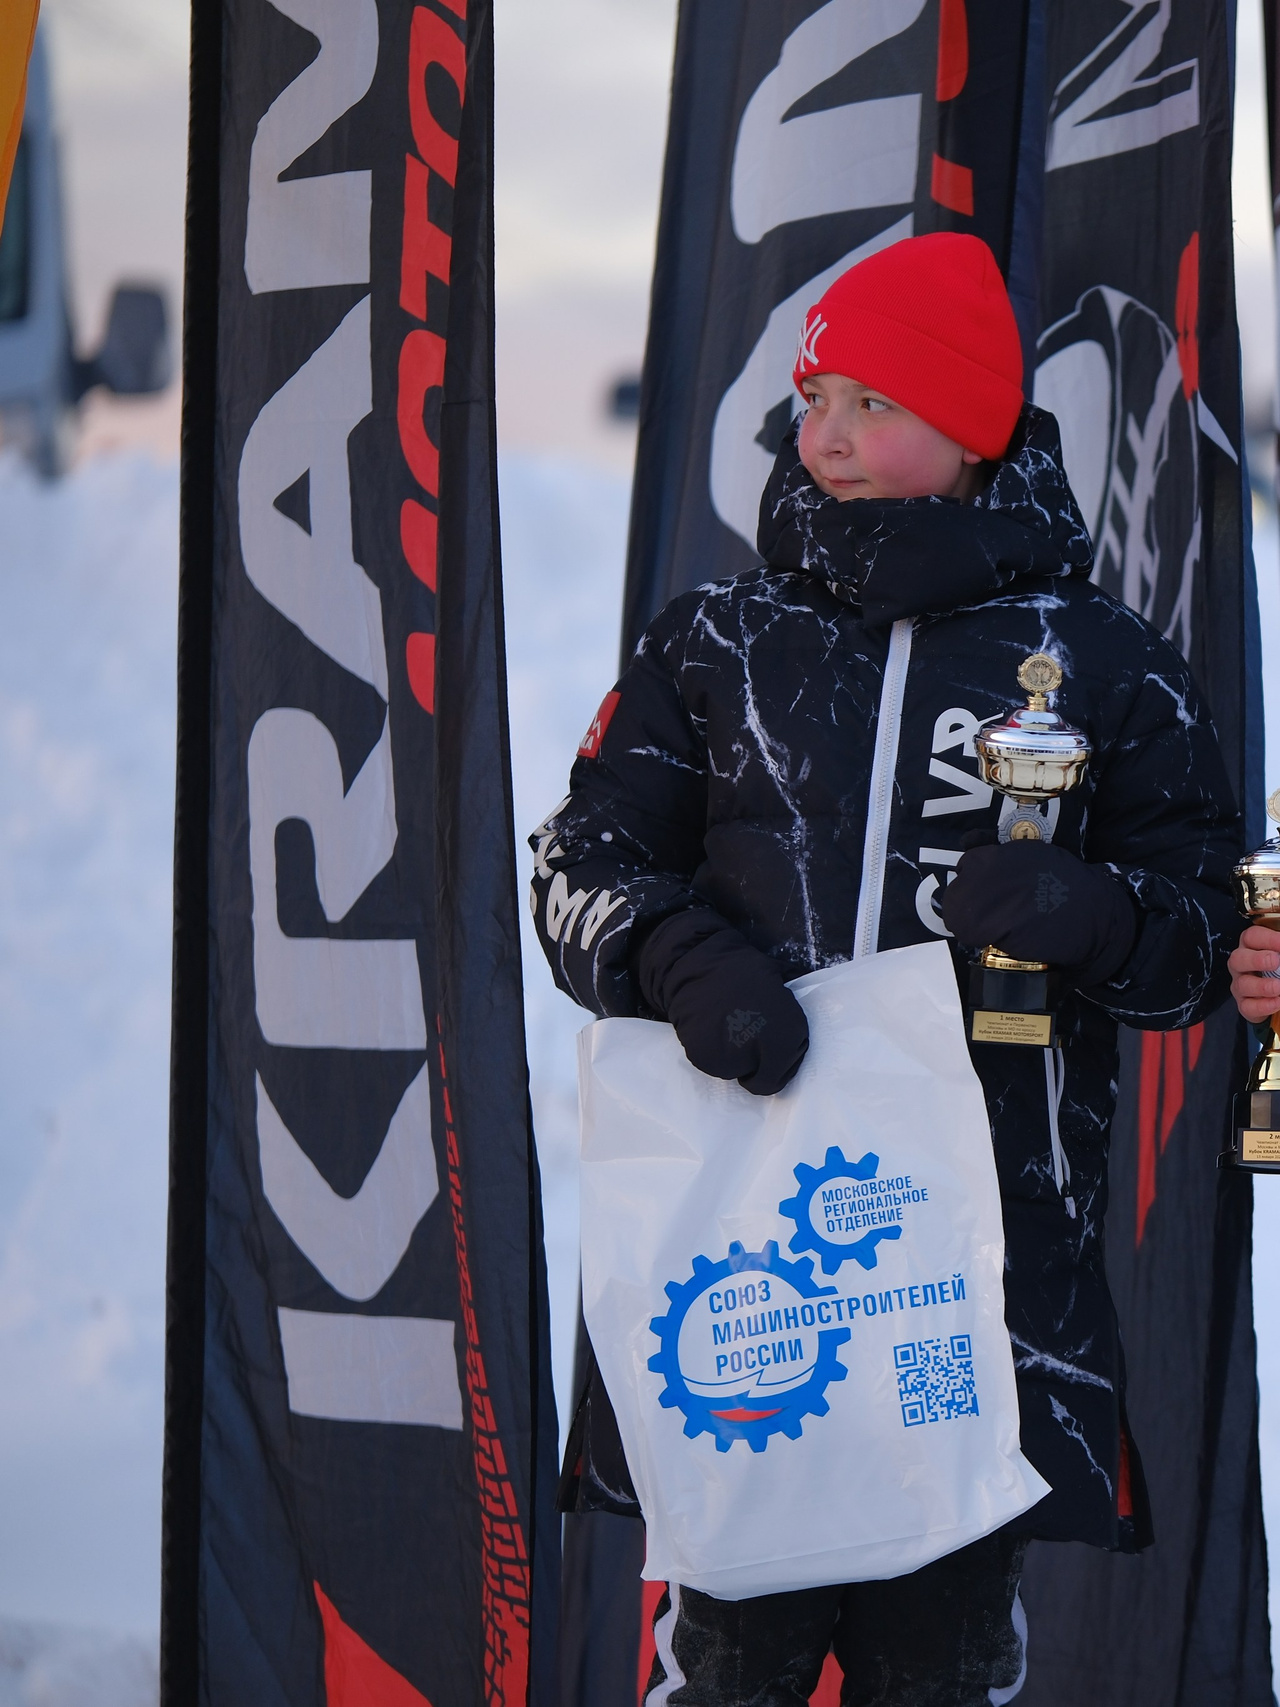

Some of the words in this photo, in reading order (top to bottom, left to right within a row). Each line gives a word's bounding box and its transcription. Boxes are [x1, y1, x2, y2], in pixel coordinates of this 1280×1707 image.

[822, 1176, 912, 1204] МОСКОВСКОЕ
[824, 1188, 929, 1218] РЕГИОНАЛЬНОЕ
[826, 1208, 904, 1234] ОТДЕЛЕНИЕ
[708, 1279, 772, 1314] СОЮЗ
[712, 1273, 966, 1346] МАШИНОСТРОИТЕЛЕЙ
[716, 1338, 804, 1376] РОССИИ
